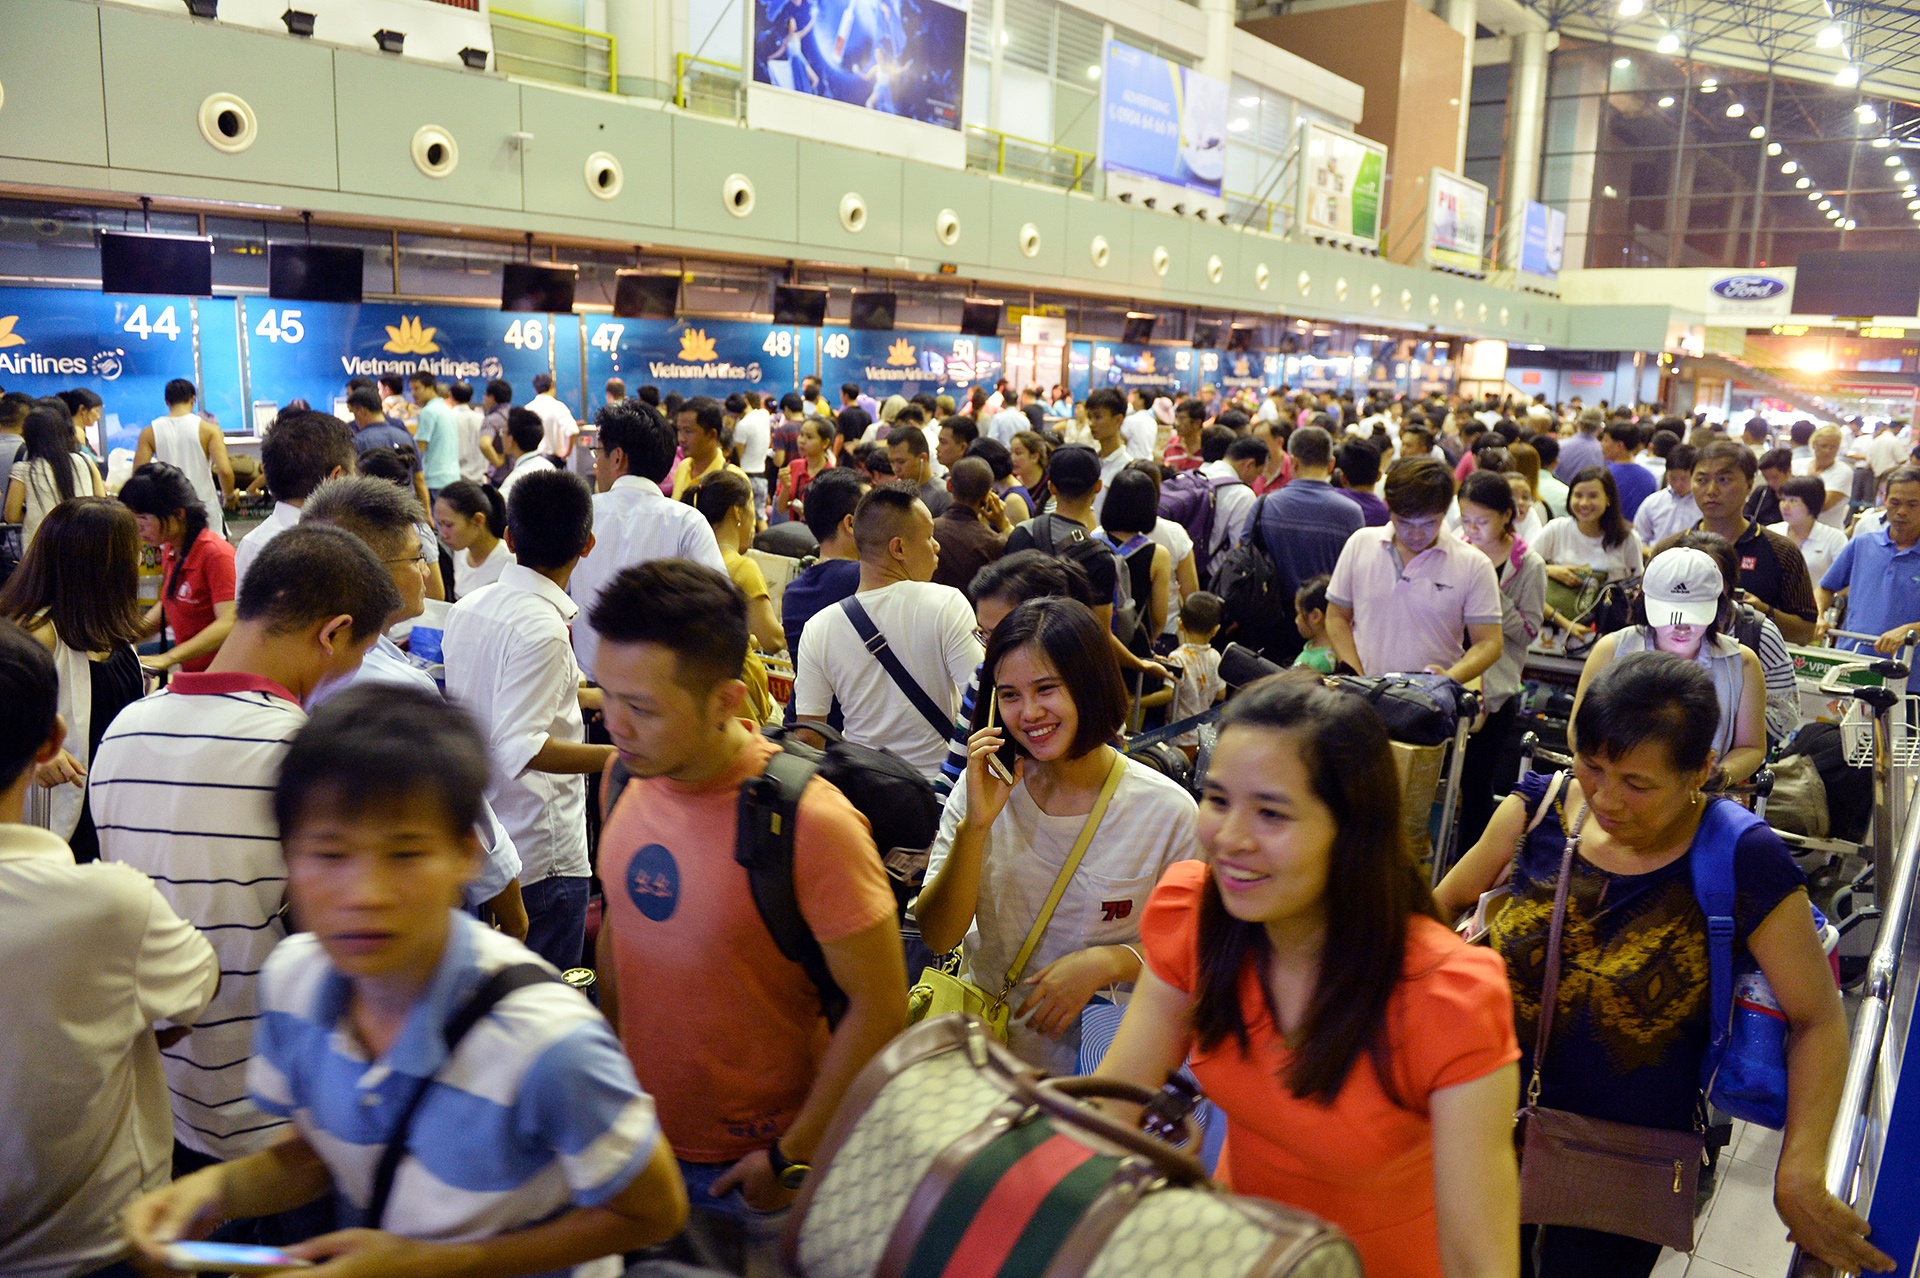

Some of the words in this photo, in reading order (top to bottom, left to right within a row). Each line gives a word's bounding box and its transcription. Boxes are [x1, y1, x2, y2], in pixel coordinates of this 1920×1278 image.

[1723, 277, 1774, 298] Ford
[124, 304, 181, 341] 44
[255, 308, 305, 344] 45
[504, 319, 543, 350] 46
[591, 322, 625, 352] 47
[762, 331, 792, 357] 48
[823, 333, 850, 359] 49
[953, 339, 974, 362] 50
[0, 352, 87, 375] Airlines
[341, 356, 419, 376] Vietnam
[418, 357, 480, 378] Airlines
[649, 361, 700, 379] Vietnam
[699, 362, 746, 380] Airlines
[1101, 899, 1133, 921] 79
